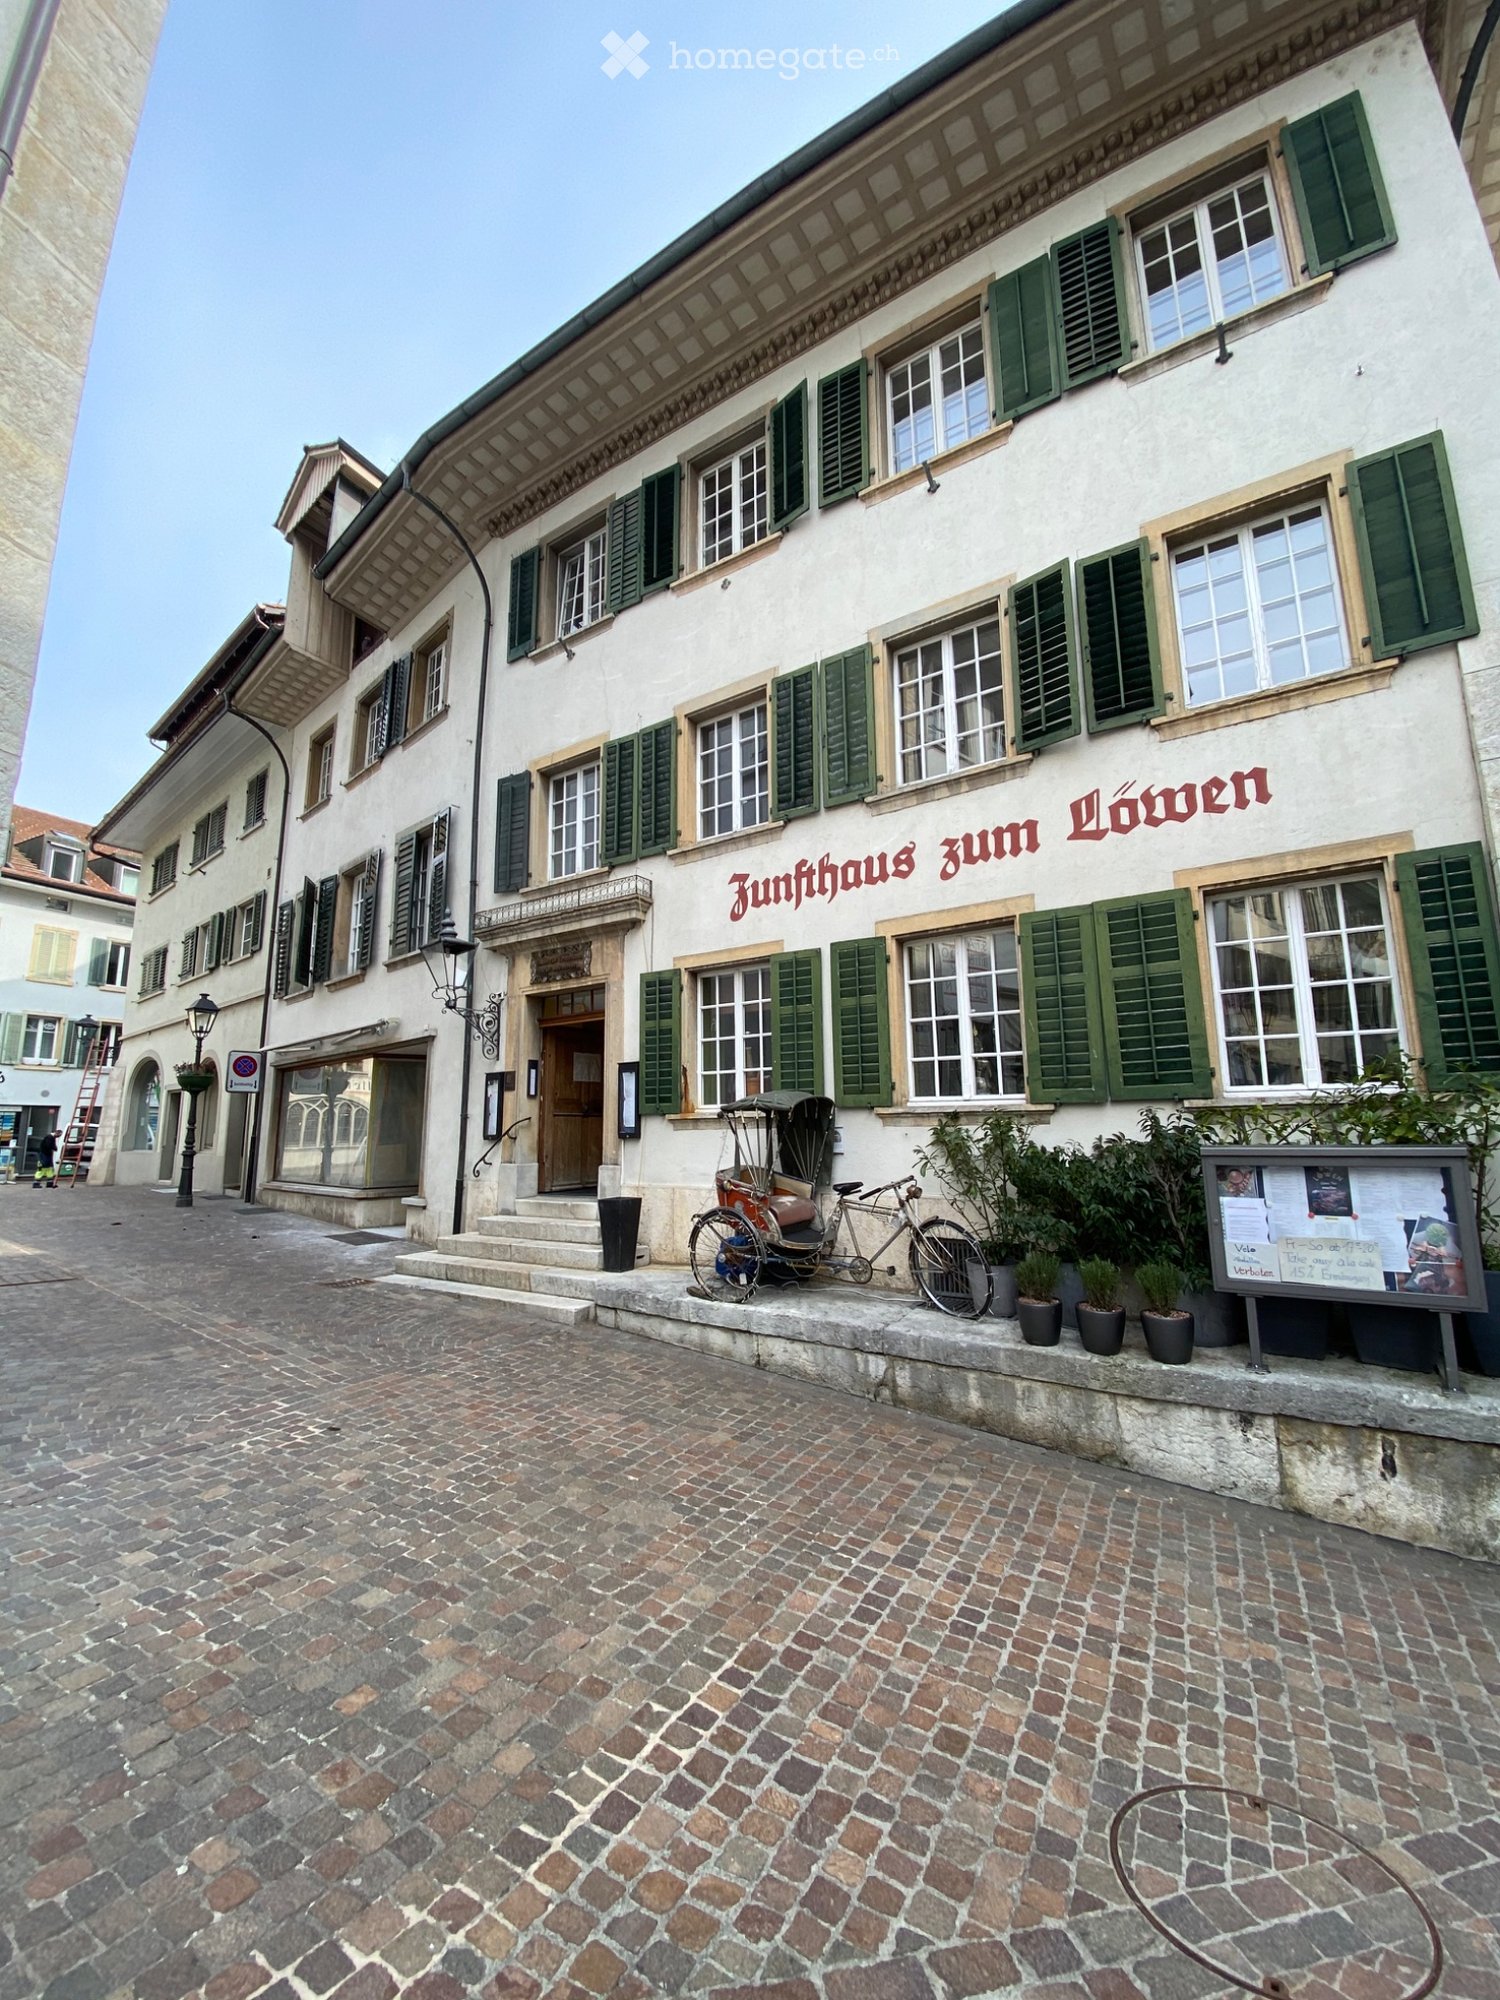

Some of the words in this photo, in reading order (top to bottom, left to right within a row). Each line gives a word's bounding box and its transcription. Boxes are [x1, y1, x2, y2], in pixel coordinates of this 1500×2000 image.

[728, 841, 916, 922] Zunfthaus
[940, 819, 1039, 881] zum
[1067, 766, 1273, 841] Löwen
